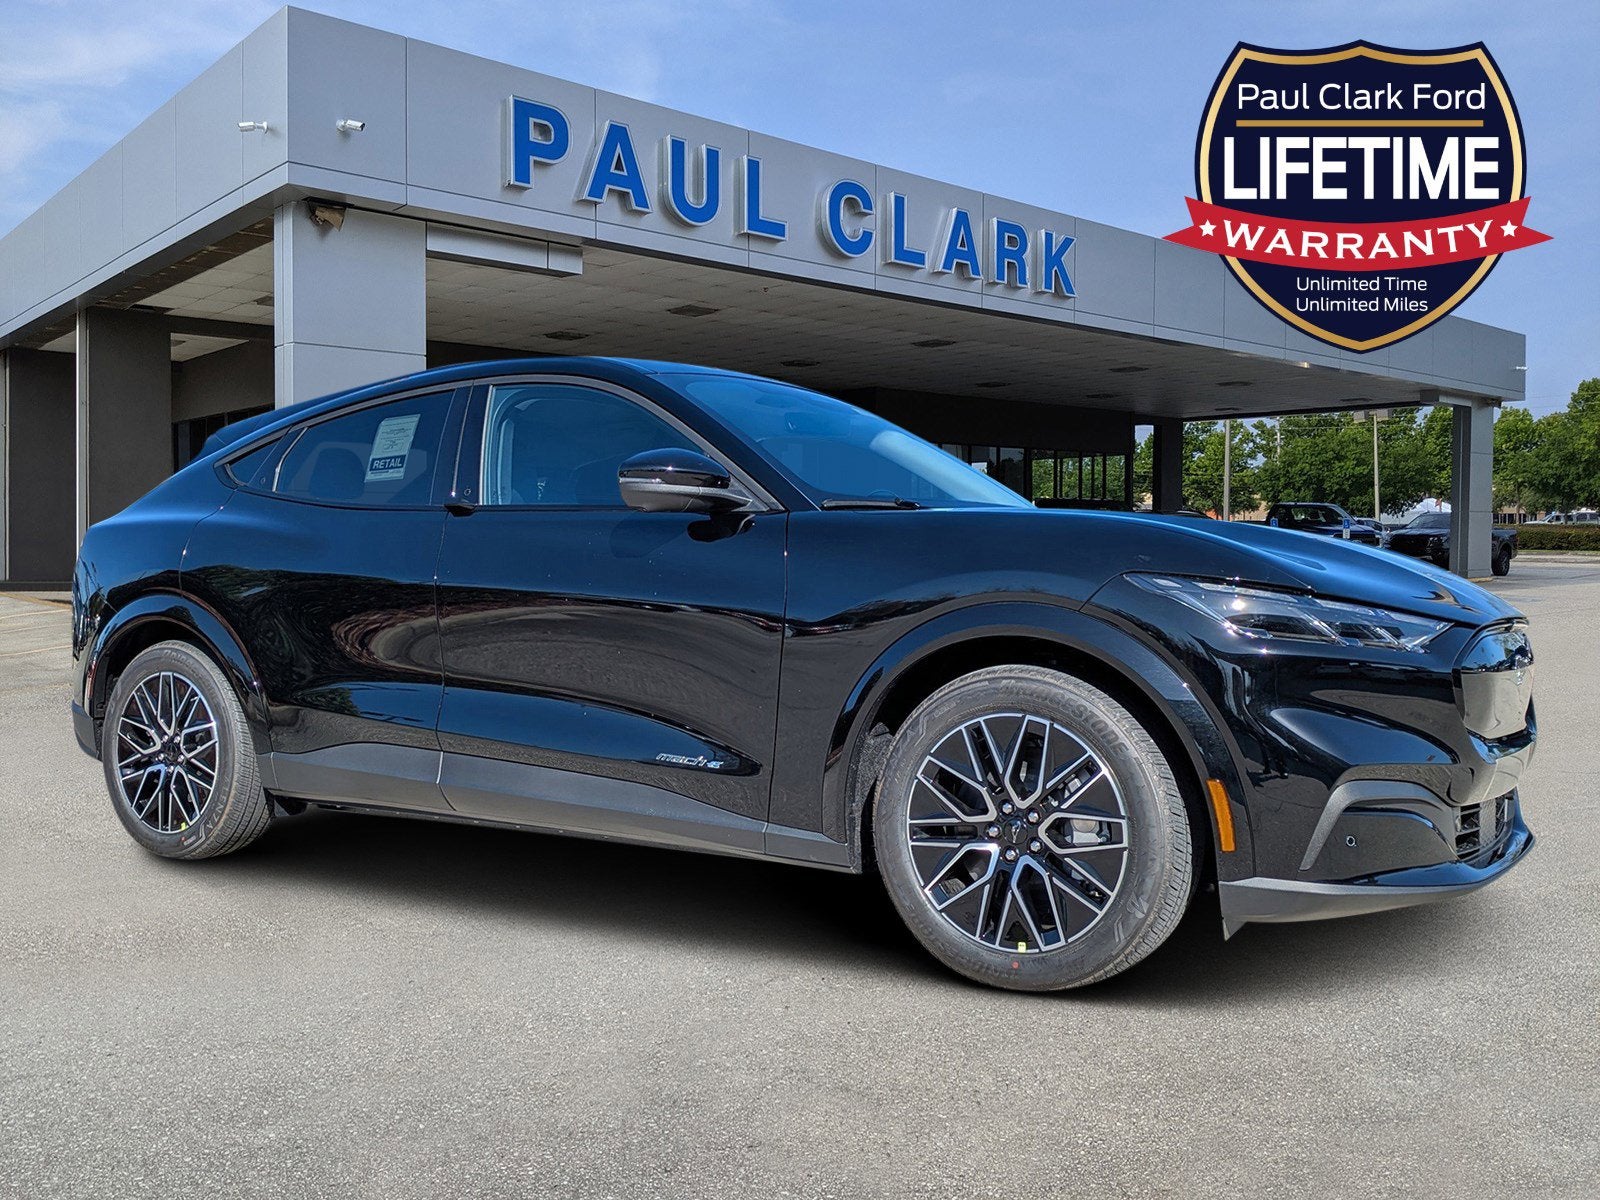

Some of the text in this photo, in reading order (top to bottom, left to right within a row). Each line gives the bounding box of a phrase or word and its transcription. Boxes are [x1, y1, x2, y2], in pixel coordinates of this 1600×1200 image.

[505, 94, 1078, 298] PAUL CLARK
[373, 458, 402, 469] RETAIL
